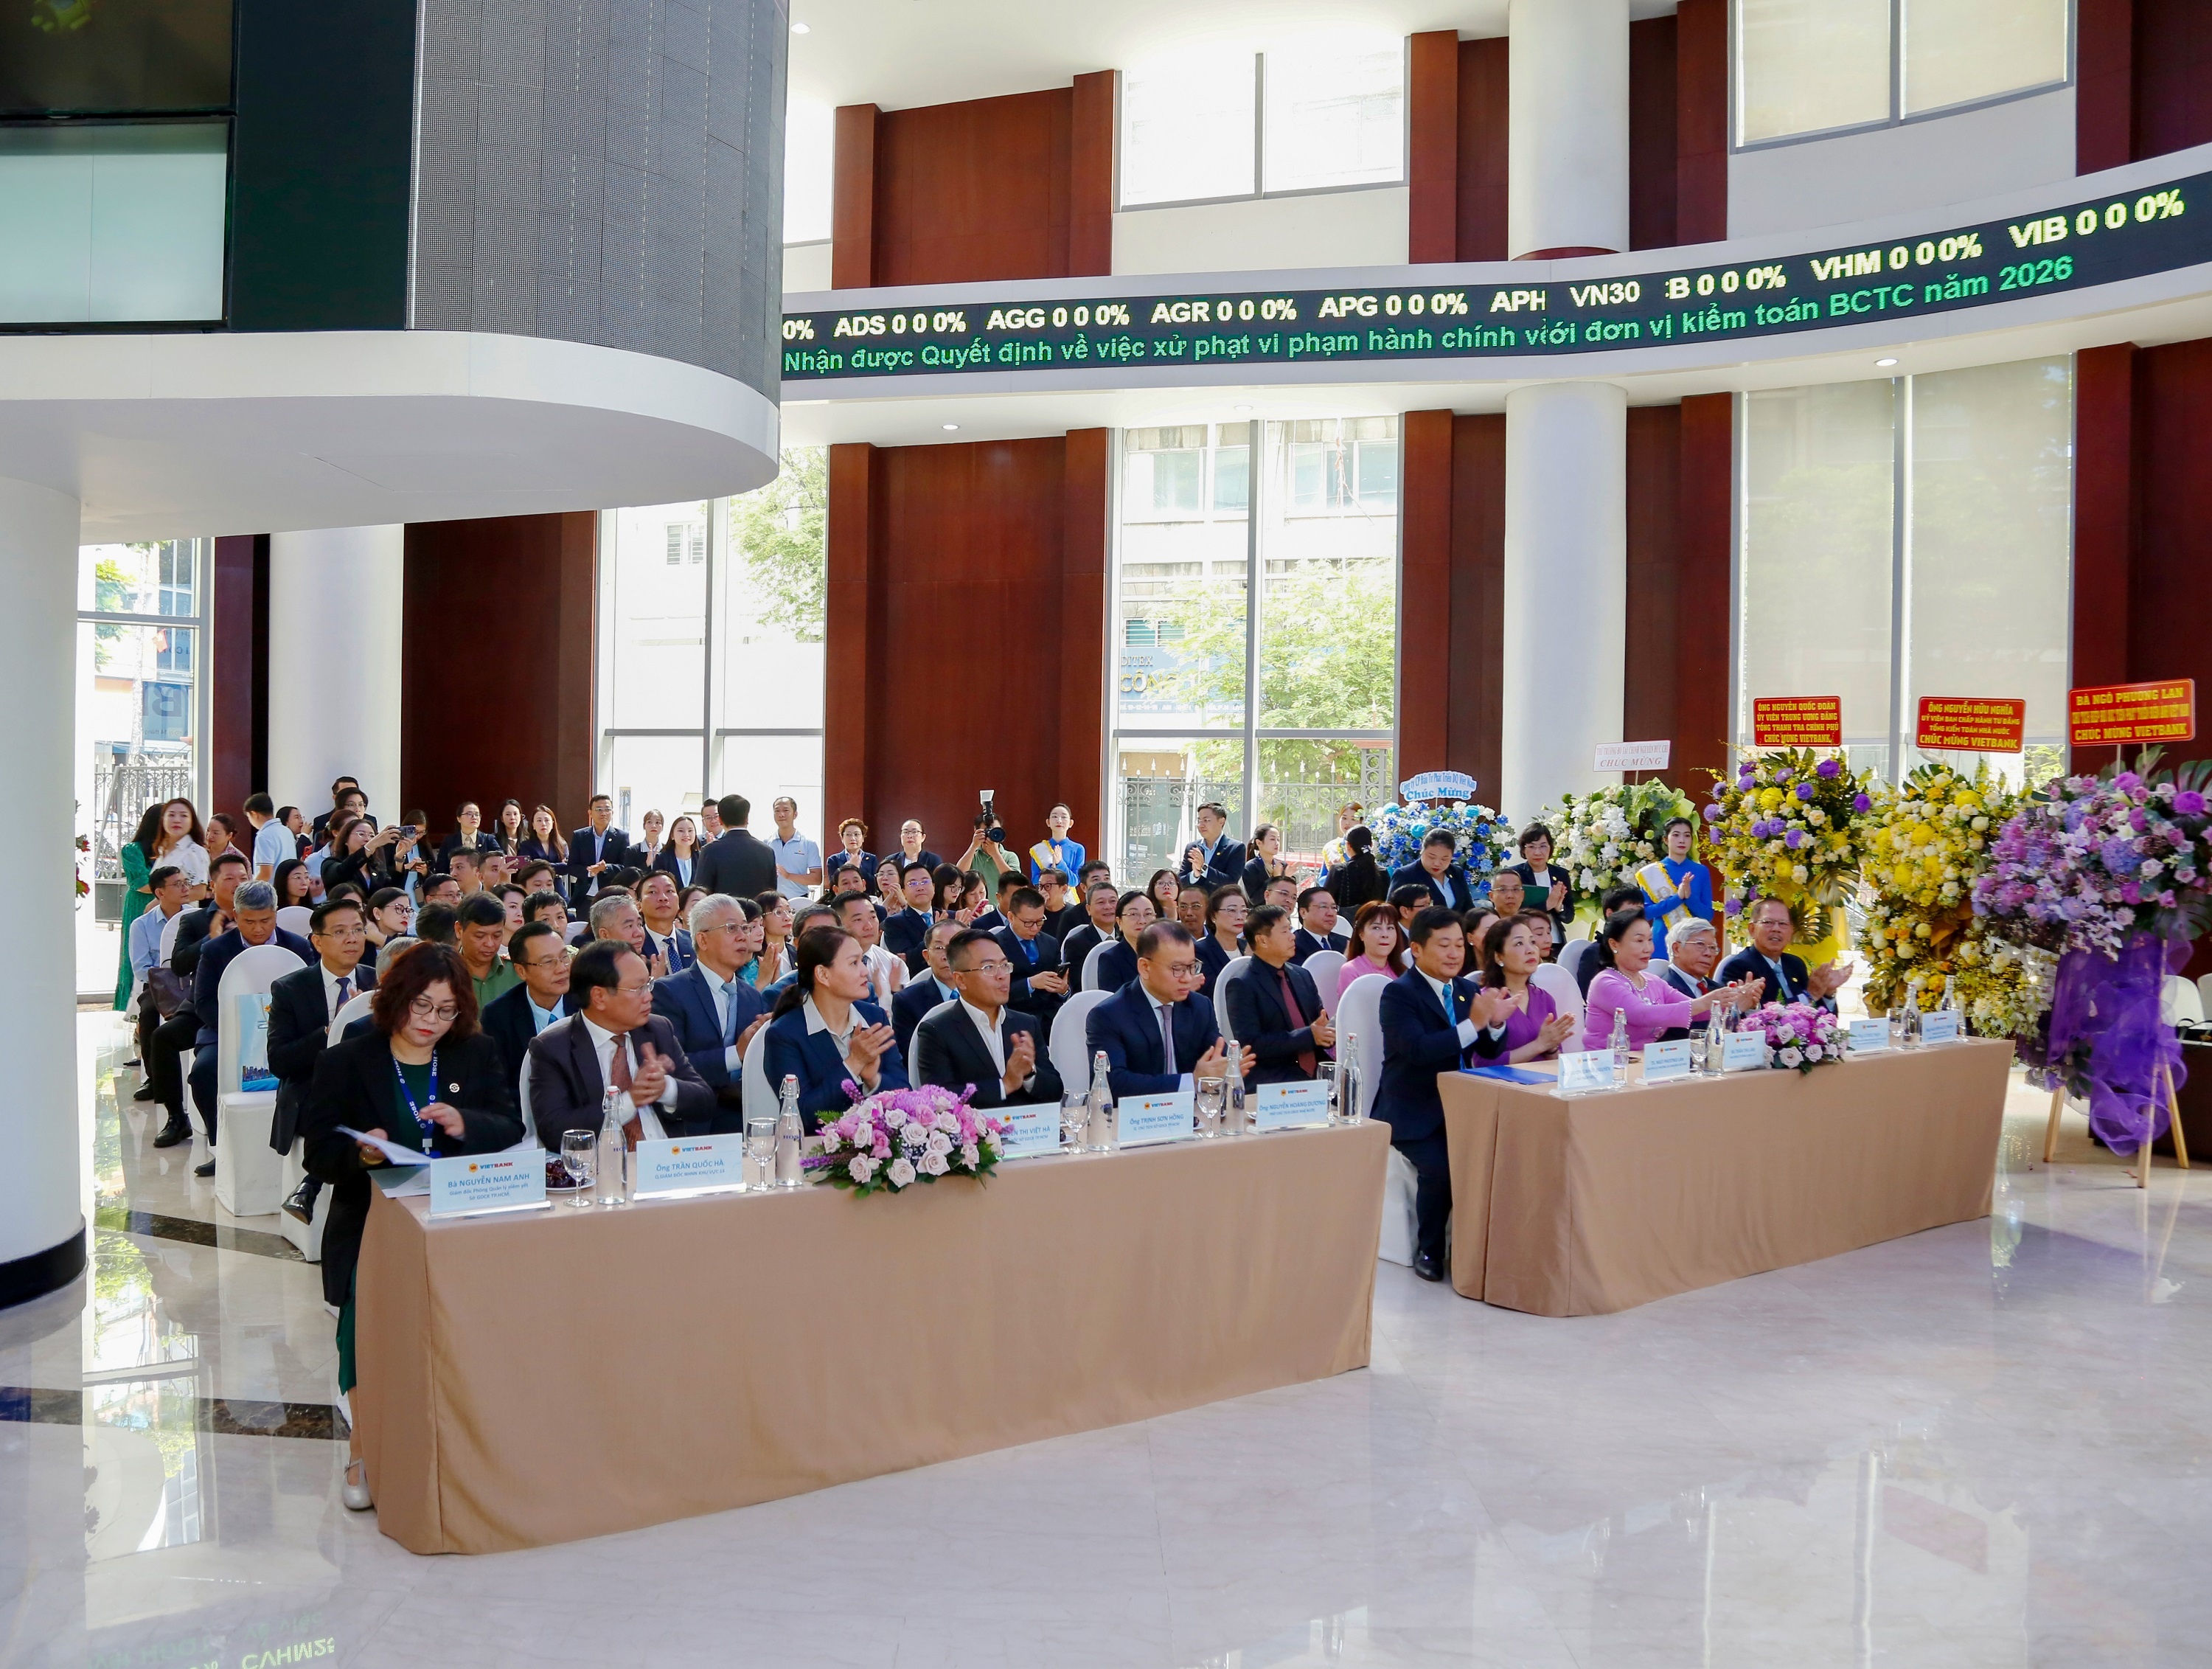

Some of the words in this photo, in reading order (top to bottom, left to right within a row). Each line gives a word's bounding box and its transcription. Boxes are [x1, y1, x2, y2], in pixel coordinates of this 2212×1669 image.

[1697, 274, 1715, 296] 0
[1721, 270, 1739, 294] 0
[1745, 265, 1787, 290] 0%
[1810, 249, 1882, 282] VHM
[1889, 246, 1909, 270] 0
[1915, 241, 1934, 266] 0
[1938, 232, 1983, 263] 0%
[2008, 215, 2068, 249] VIB
[2075, 209, 2097, 237] 0
[2104, 202, 2128, 230] 0
[2134, 188, 2185, 221] 0%
[1569, 281, 1641, 308] VN30
[1585, 321, 1639, 342] đơn
[1649, 314, 1672, 339] vị
[1683, 302, 1745, 334] kiểm
[1756, 298, 1819, 325] toán
[1829, 283, 1915, 317] BCTC
[1924, 273, 1989, 303] năm
[1999, 255, 2074, 292] 2026
[833, 314, 886, 338] ADS
[892, 314, 907, 335] 0
[912, 313, 927, 333] 0
[933, 311, 967, 333] 0%
[986, 308, 1046, 330] AGG
[1053, 307, 1068, 327] 0
[1074, 306, 1088, 327] 0
[1095, 304, 1130, 326] 0%
[1150, 301, 1210, 324] AGR
[1217, 300, 1232, 322] 0
[1239, 299, 1254, 320] 0
[1261, 298, 1298, 321] 0%
[1318, 296, 1377, 319] APG
[1385, 294, 1401, 316] 0
[1408, 294, 1424, 314] 0
[1431, 292, 1468, 315] 0%
[1489, 290, 1546, 313] APH
[784, 349, 843, 375] Nhận
[852, 347, 914, 371] được
[921, 336, 992, 369] Quyết
[998, 340, 1052, 367] định
[1060, 333, 1090, 361] về
[1096, 336, 1144, 363] việc
[1152, 333, 1187, 358] xử
[1194, 333, 1250, 361] phạt
[1258, 333, 1279, 355] vi
[1288, 330, 1358, 358] phạm
[1368, 326, 1432, 351] hành
[1441, 324, 1515, 349] chính
[2161, 687, 2184, 699] LAN
[1758, 703, 1770, 711] ÔNG
[1799, 701, 1815, 711] QUỐC
[1928, 702, 1943, 712] ÔNG
[1944, 701, 1972, 713] NGUYỄN
[1991, 704, 2014, 715] NGHĨA
[1806, 722, 1825, 731] CHÍNH
[2075, 726, 2101, 740] CHÚC
[2135, 724, 2187, 737] VIETBANK
[1764, 732, 1780, 743] CHÚC
[1800, 734, 1832, 743] VIETBANK
[1920, 733, 1942, 744] CHÚC
[1943, 734, 1969, 746] MỪNG
[1971, 738, 2018, 749] VIETBANK
[1600, 757, 1627, 767] CHÚC
[1631, 756, 1662, 766] MỪNG
[1406, 788, 1434, 800] Chúc
[1437, 787, 1470, 799] Mừng
[409, 1101, 421, 1123] HOSE
[1030, 1126, 1041, 1134] VIỆT
[480, 1162, 513, 1170] VIETBANK
[656, 1162, 670, 1173] Ông
[672, 1161, 690, 1170] TRẦN
[692, 1159, 712, 1169] QUỐC
[714, 1158, 724, 1166] HÀ
[459, 1175, 491, 1187] NGUYỄN
[493, 1175, 512, 1184] NAM
